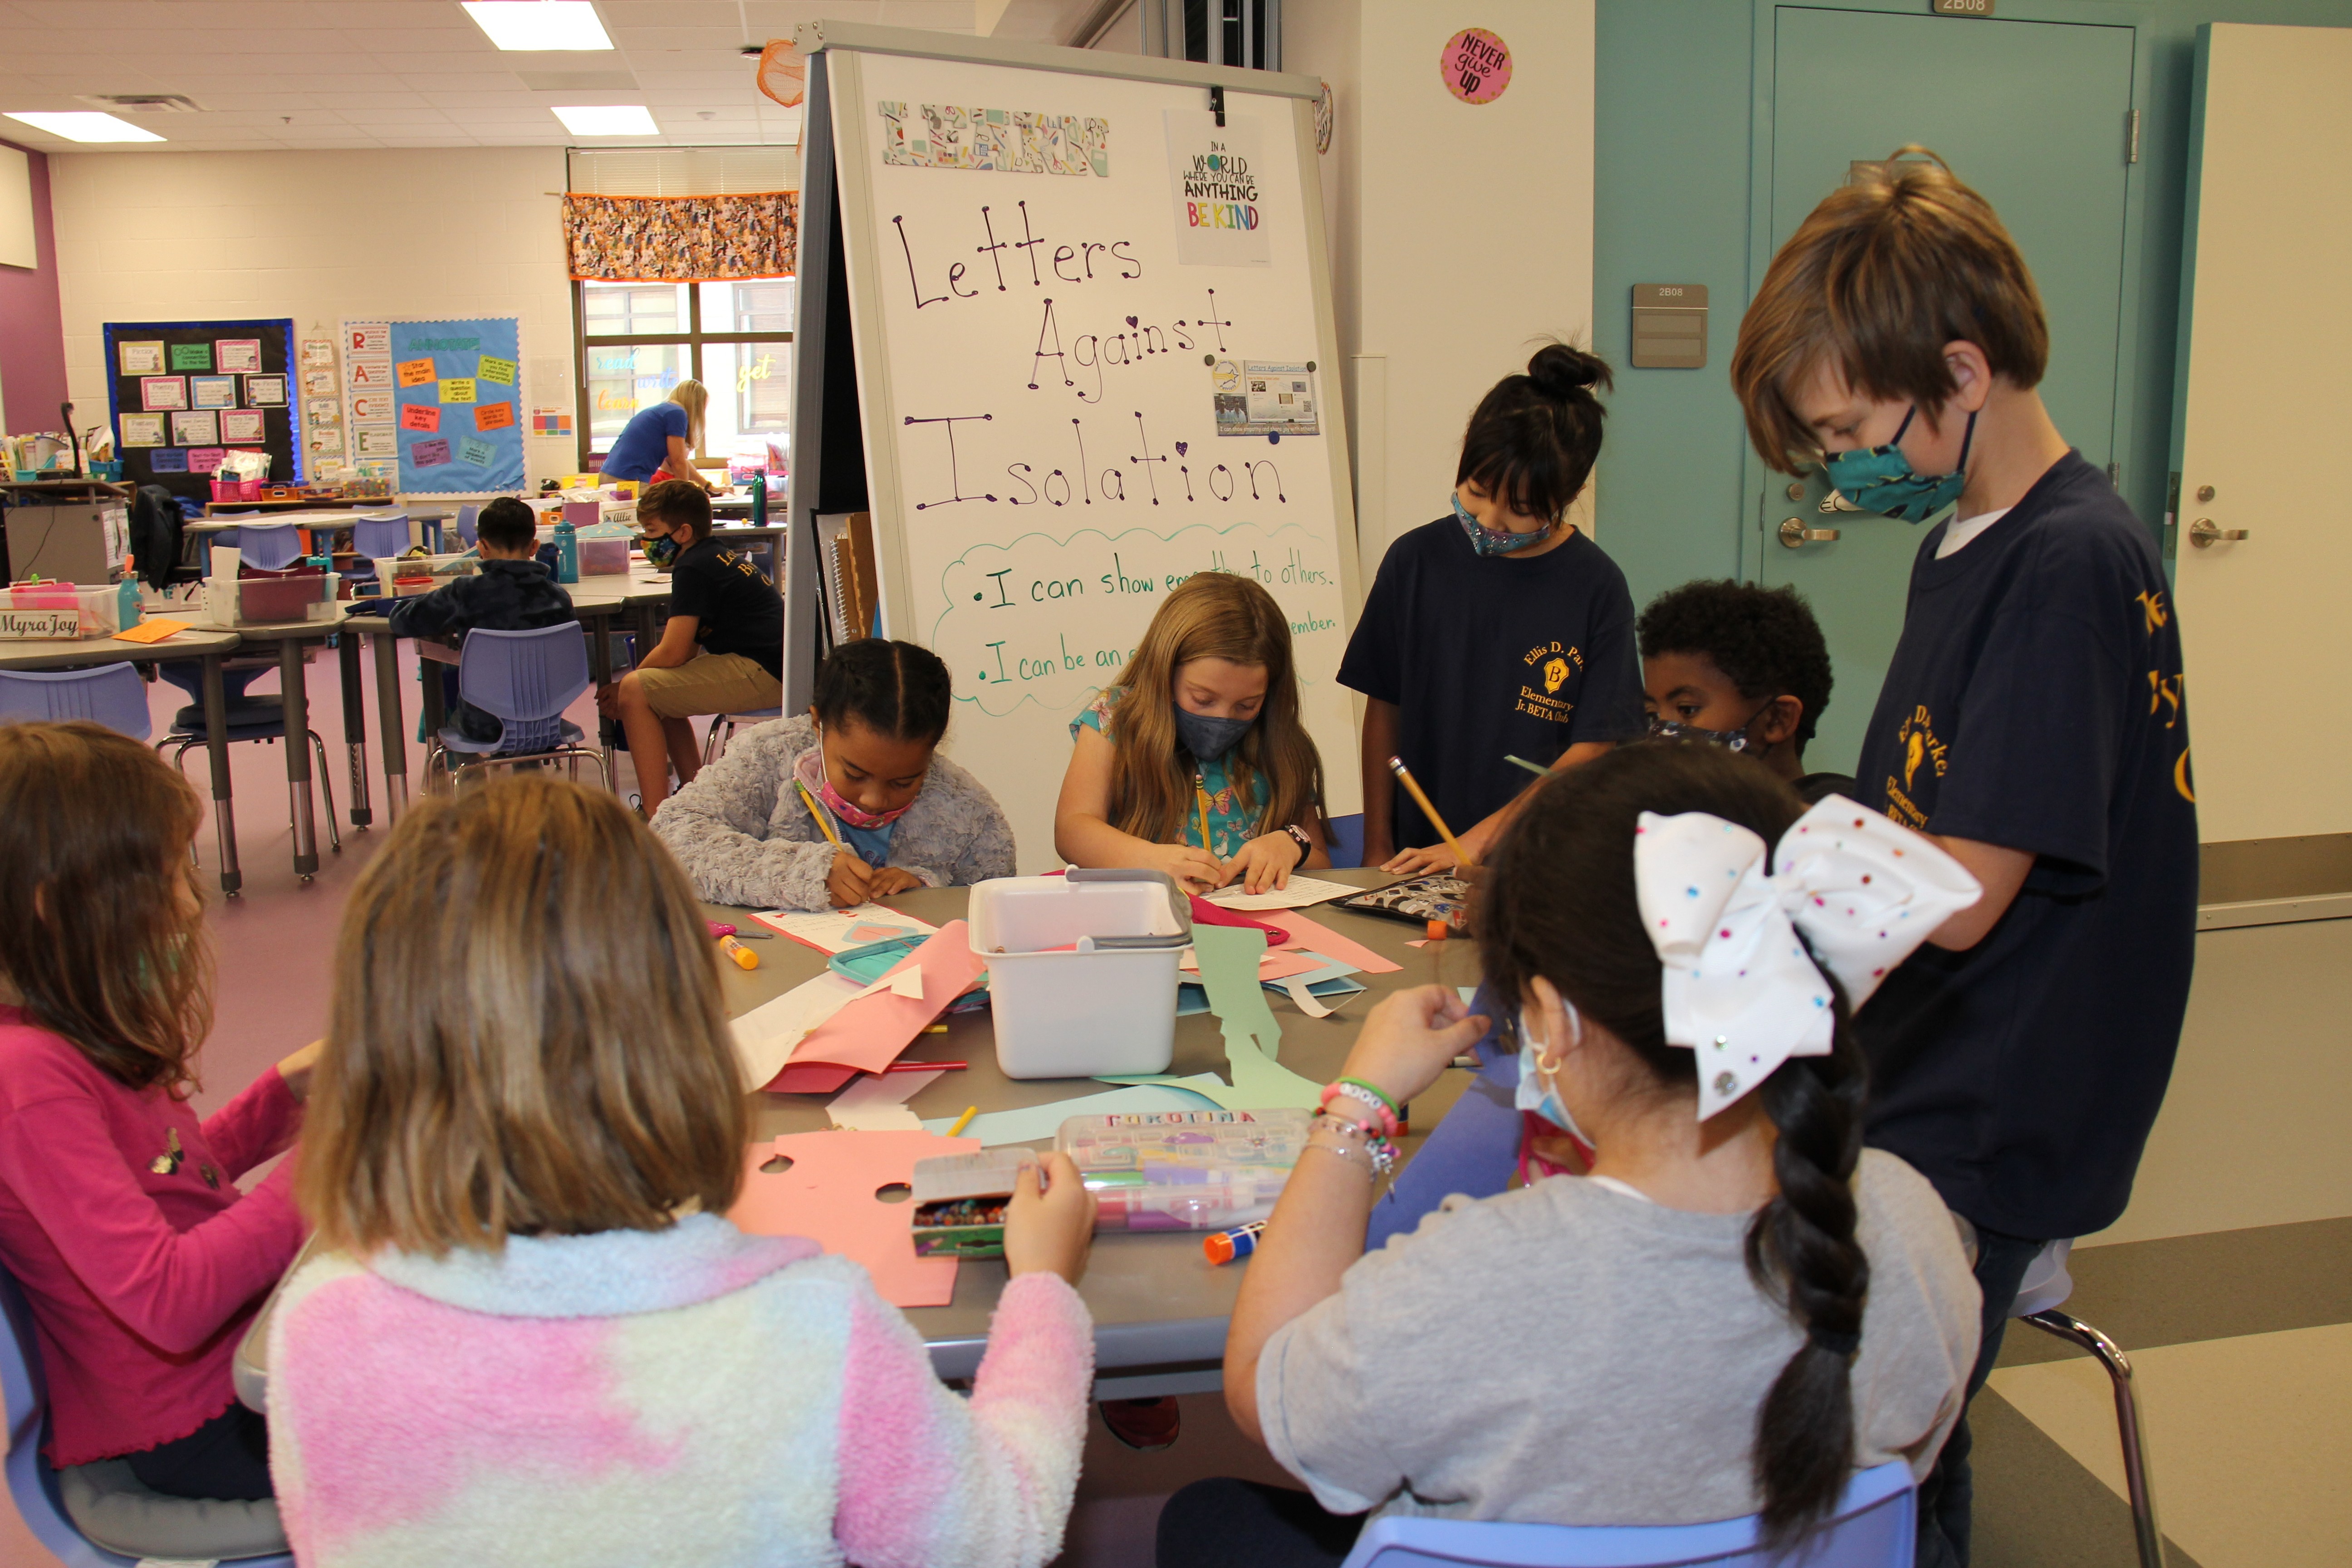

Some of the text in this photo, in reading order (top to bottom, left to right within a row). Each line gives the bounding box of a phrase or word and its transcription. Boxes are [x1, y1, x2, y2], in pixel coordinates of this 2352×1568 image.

[1461, 33, 1505, 70] NEVER
[1455, 53, 1491, 78] give
[878, 101, 1109, 177] LEARN
[1211, 141, 1226, 152] IN A
[1192, 155, 1247, 175] WORLD
[1184, 170, 1254, 185] WHERE YOU CAN BE
[1185, 181, 1258, 202] ANYTHING
[1187, 202, 1259, 230] BE KIND
[892, 201, 1142, 309] Letters
[1659, 288, 1683, 296] 2B08
[353, 332, 365, 349] R
[1028, 288, 1231, 404] Against
[596, 348, 640, 370] read
[354, 365, 369, 382] A
[737, 353, 776, 393] yet
[355, 399, 368, 416] C
[597, 389, 641, 411] learn
[407, 407, 436, 416] Underline
[358, 431, 369, 451] E
[904, 411, 1286, 510] Isolation
[614, 512, 632, 523] Allie
[986, 568, 1016, 609] I
[1031, 578, 1083, 602] can
[1105, 552, 1154, 594] show
[1250, 550, 1272, 583] to
[1281, 547, 1333, 585] others.
[0, 614, 78, 636] Myra Joy
[985, 640, 1013, 684] I
[1019, 658, 1056, 680] can
[1060, 632, 1086, 670] be
[1096, 650, 1122, 666] an
[1524, 642, 1584, 672] Ellis D. Par
[1548, 666, 1561, 682] B
[1520, 685, 1574, 712] Elementary
[1515, 699, 1569, 723] Jr. BETA Club
